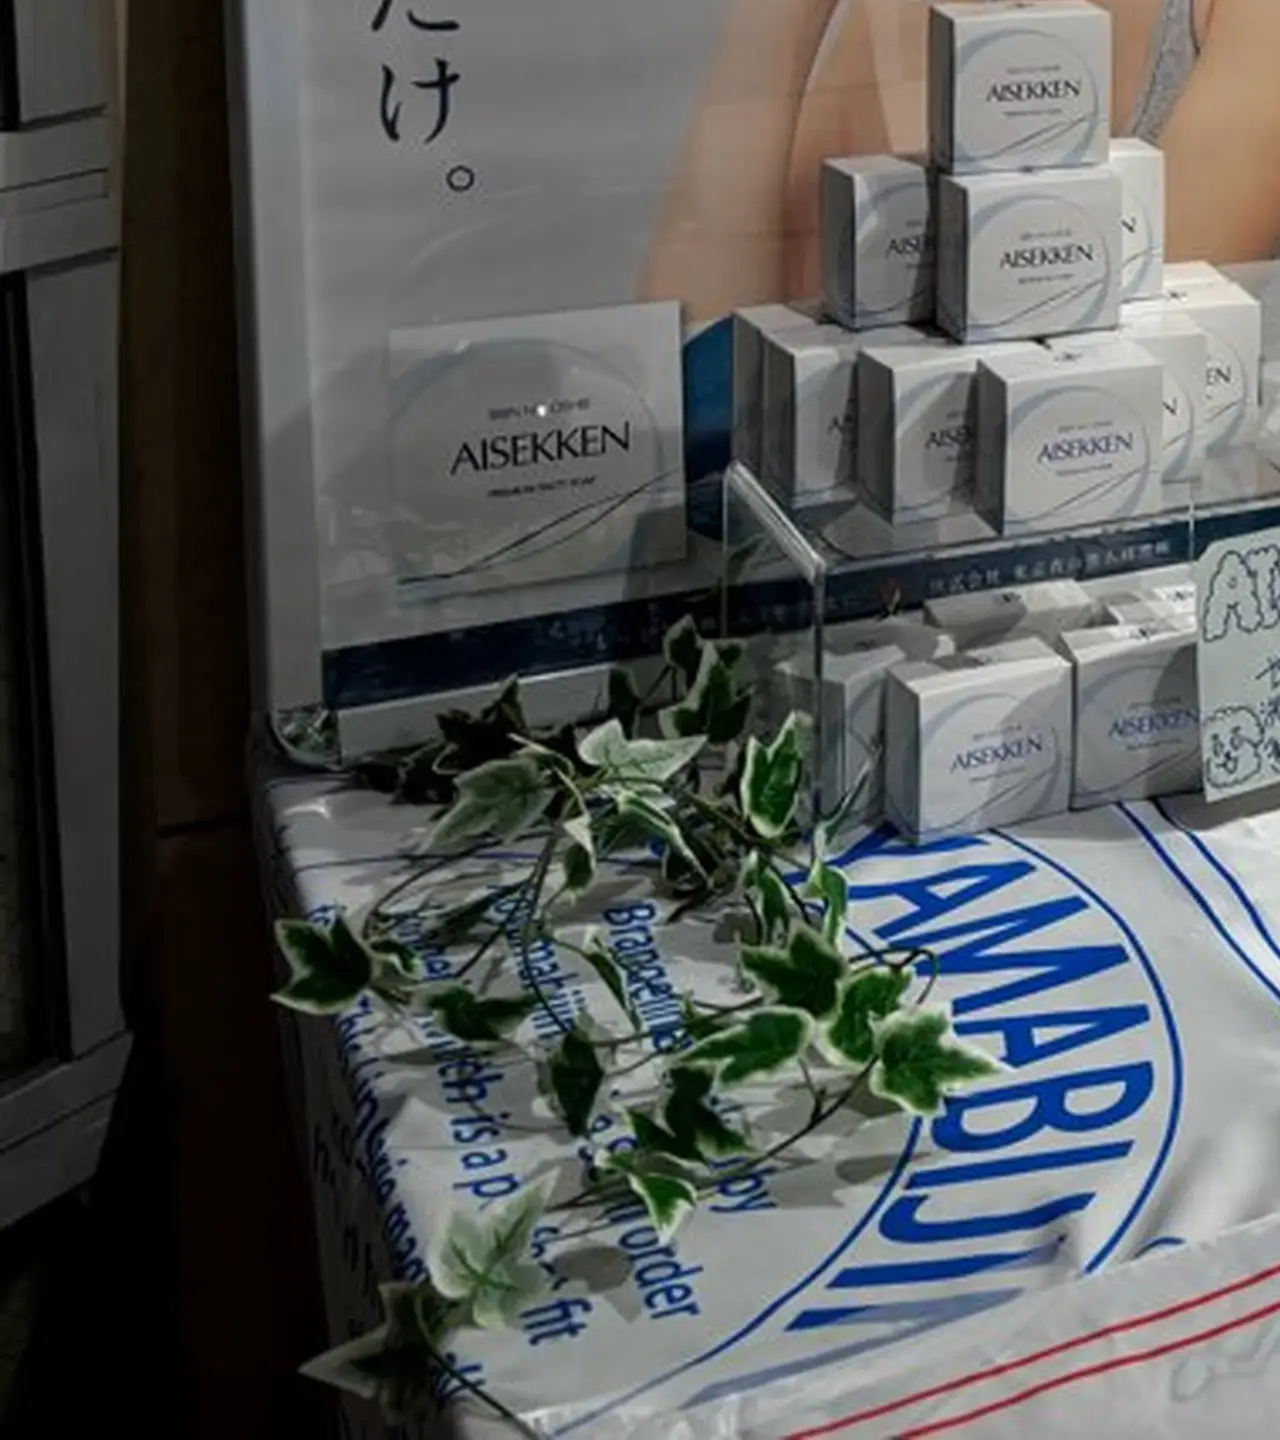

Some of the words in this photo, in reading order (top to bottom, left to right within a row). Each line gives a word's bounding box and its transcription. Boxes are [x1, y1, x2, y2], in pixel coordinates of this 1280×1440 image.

[985, 78, 1081, 103] AISEKKEN
[1000, 242, 1095, 269] AISEKKEN
[450, 420, 631, 476] AISEKKEN
[1037, 431, 1135, 464] AISEKKEN
[950, 732, 1043, 774] AISEKKEN
[450, 1113, 511, 1144] is
[460, 1148, 508, 1171] a
[618, 1224, 704, 1320] order
[519, 1297, 594, 1347] fit
